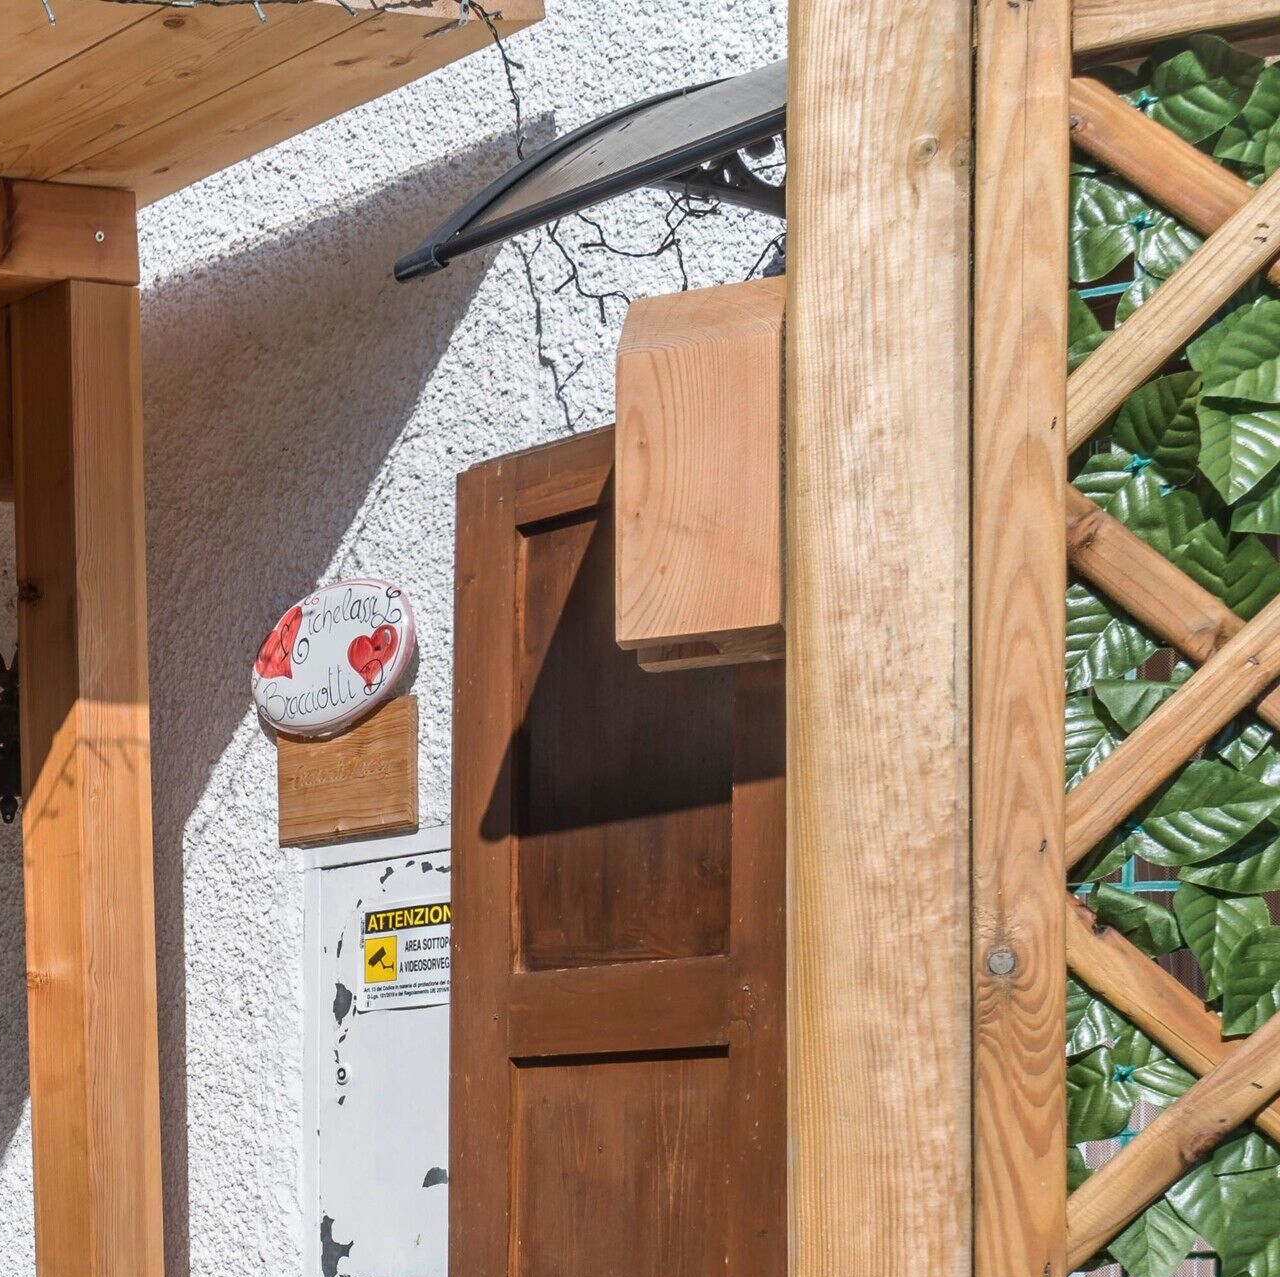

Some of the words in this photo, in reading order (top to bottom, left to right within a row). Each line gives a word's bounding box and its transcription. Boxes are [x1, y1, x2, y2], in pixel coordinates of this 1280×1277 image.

[405, 939, 422, 953] AREA
[422, 936, 452, 951] SOTTOP
[399, 961, 404, 973] A
